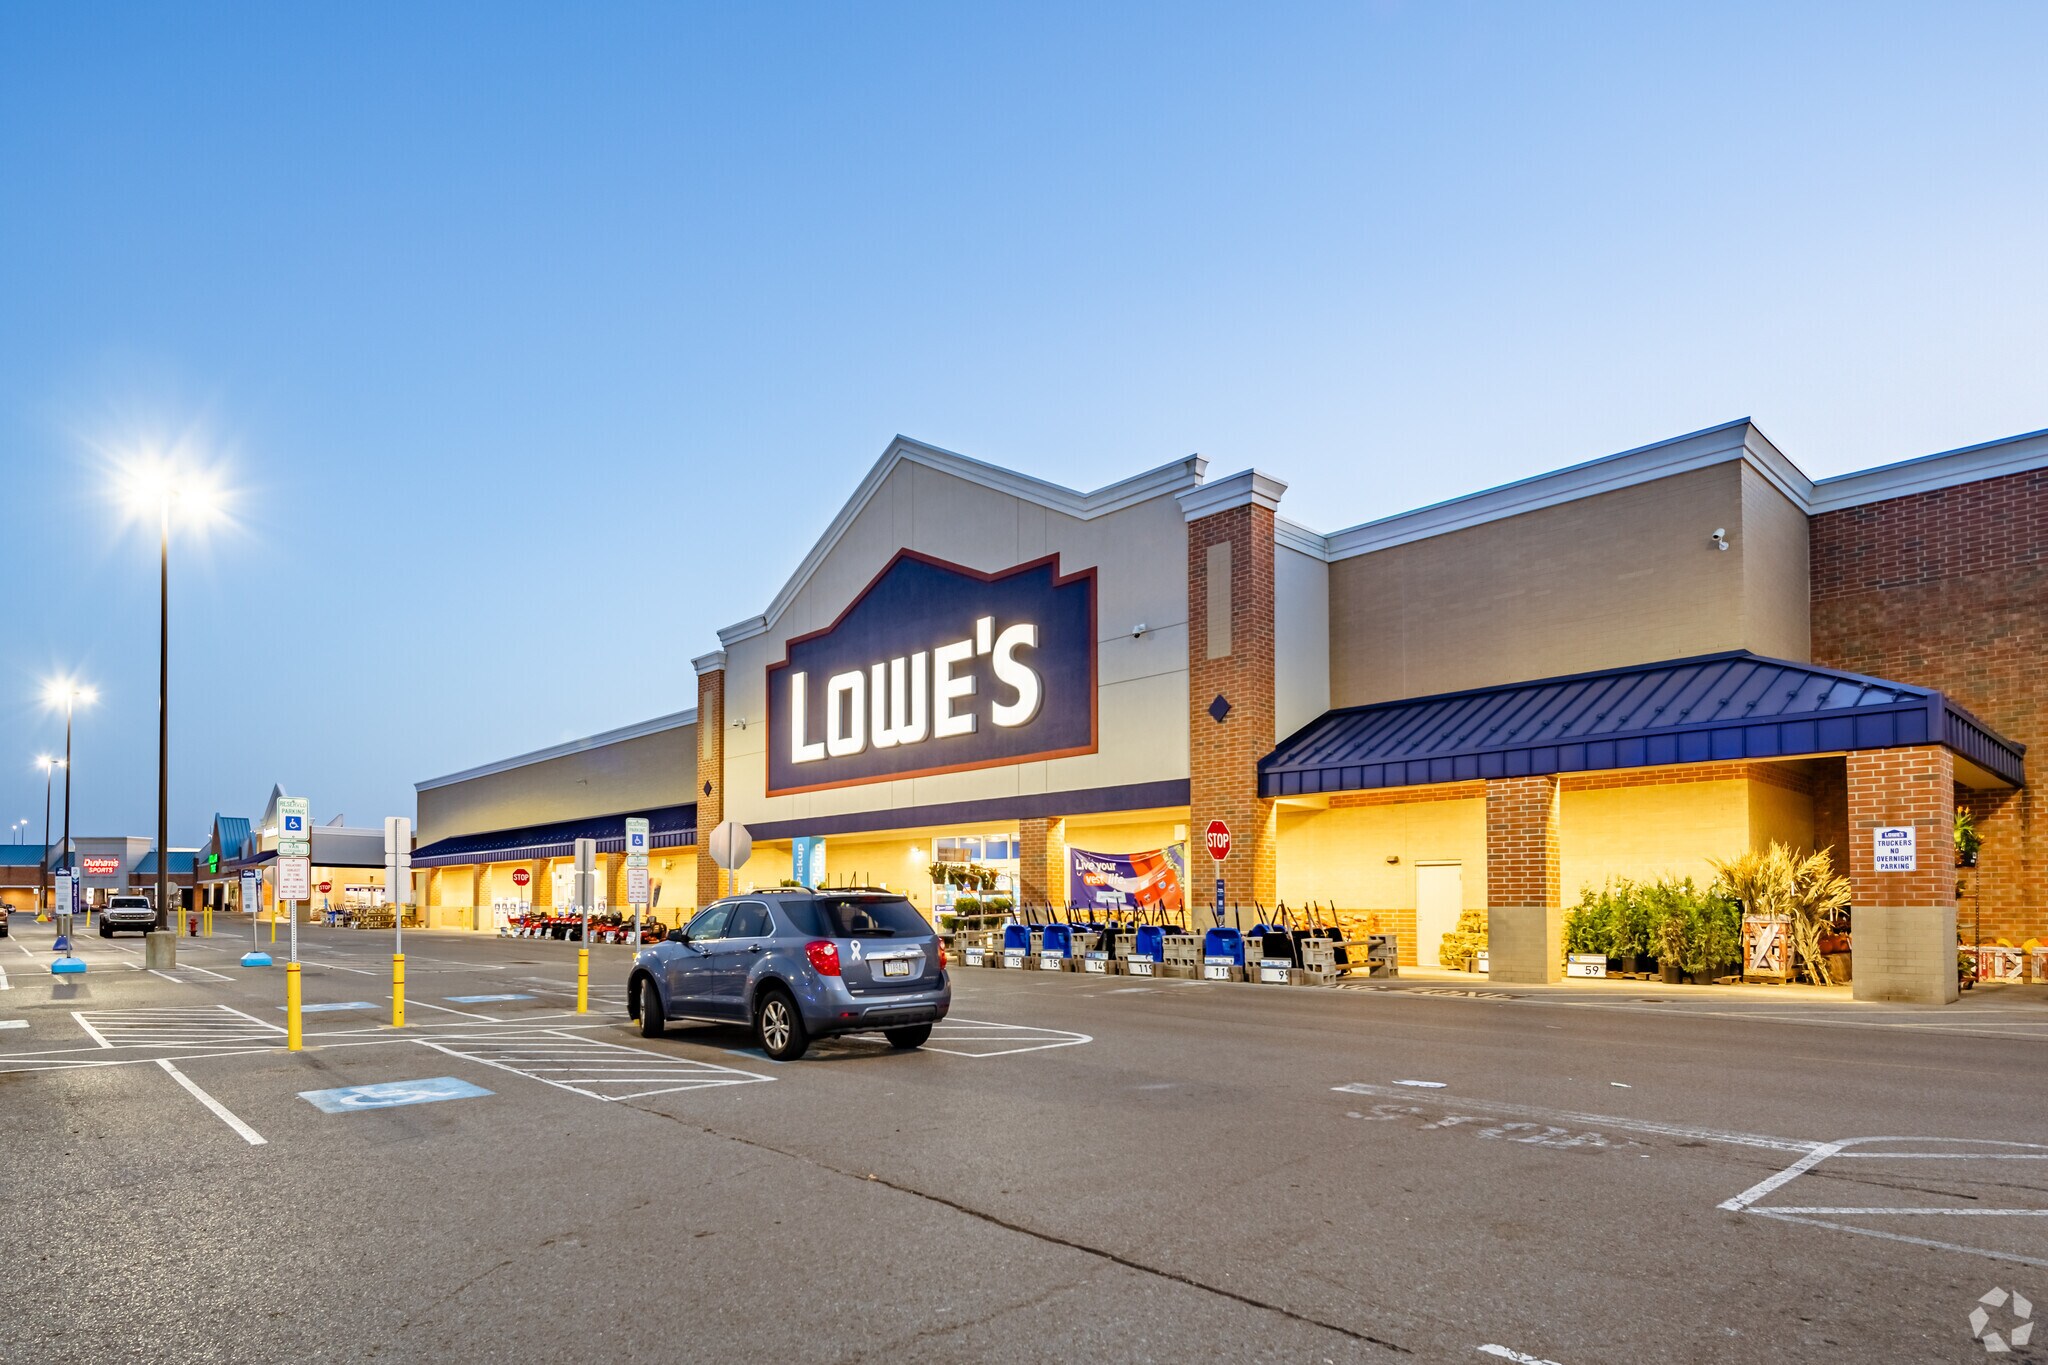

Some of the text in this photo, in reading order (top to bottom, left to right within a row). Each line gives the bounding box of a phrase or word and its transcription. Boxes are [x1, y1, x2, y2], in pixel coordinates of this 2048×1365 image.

[791, 616, 1042, 765] LOWE'S
[1208, 832, 1229, 848] STOP
[83, 858, 119, 867] Dunham's
[1075, 857, 1116, 872] Live your
[513, 873, 529, 881] STOP
[1085, 874, 1105, 884] vest
[1585, 965, 1599, 975] 59
